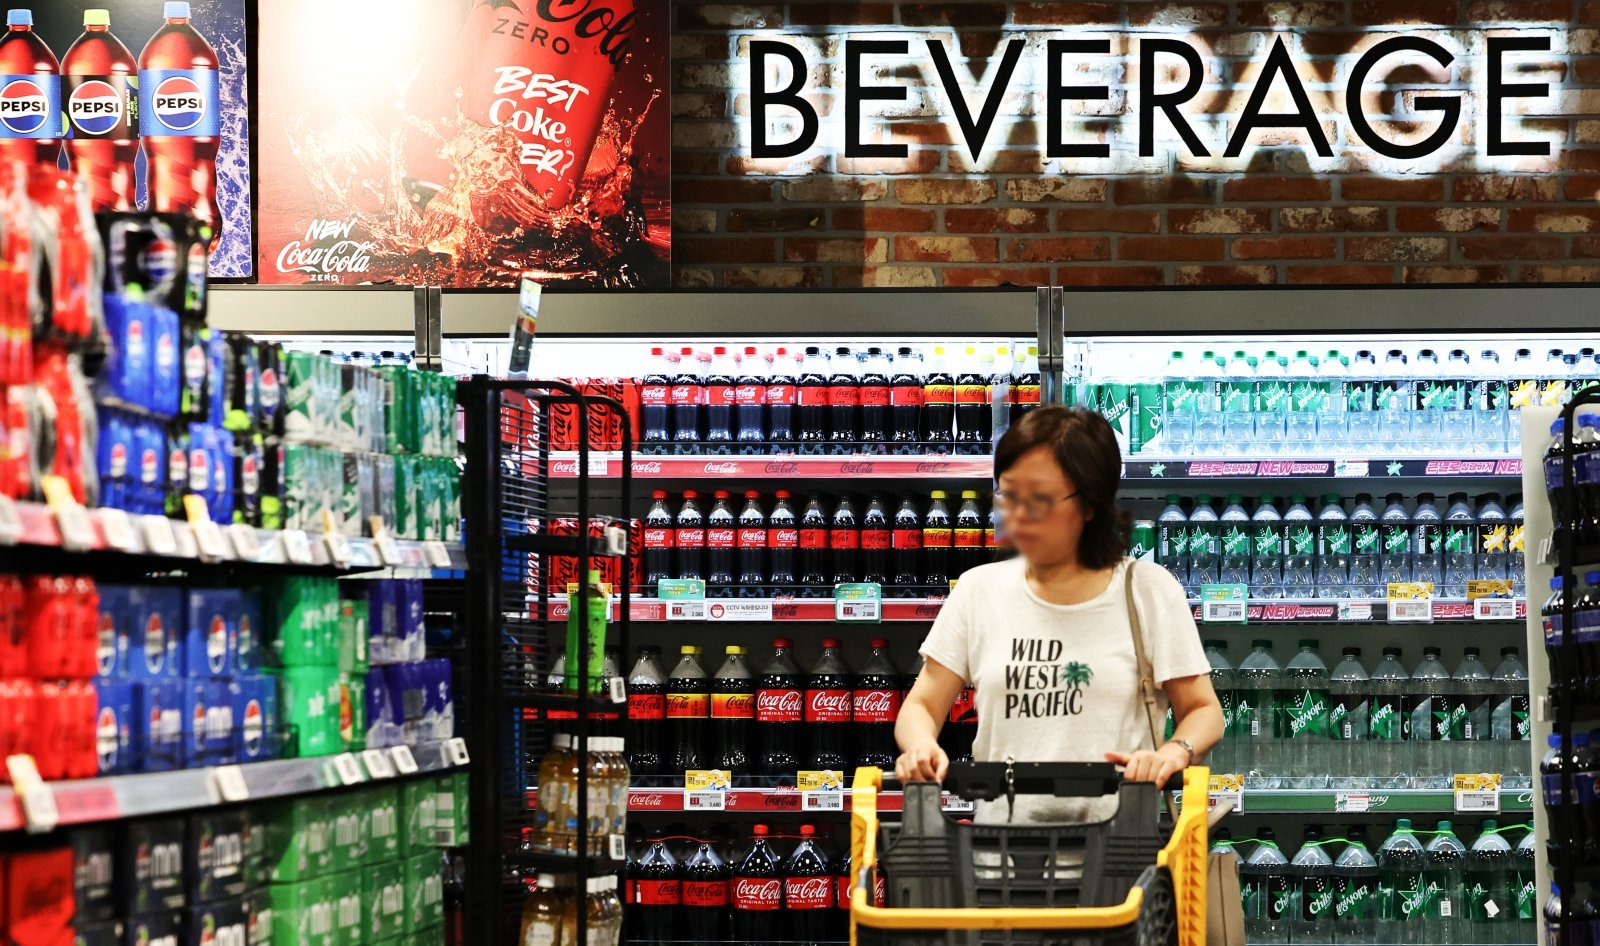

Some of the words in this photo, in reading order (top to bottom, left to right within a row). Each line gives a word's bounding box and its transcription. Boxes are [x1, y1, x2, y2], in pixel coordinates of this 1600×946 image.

[492, 18, 570, 55] ZERO
[493, 66, 589, 112] BEST
[748, 35, 1553, 163] BEVERAGE
[1, 101, 46, 112] PEPSI
[73, 102, 119, 113] PEPSI
[157, 98, 203, 109] PEPSI
[489, 98, 567, 143] Coke
[305, 216, 357, 241] NEW
[276, 240, 376, 273] Coca-Cola
[310, 274, 339, 282] ZERO
[1257, 461, 1295, 476] NEW
[1356, 529, 1378, 549] Chilsung
[1385, 529, 1409, 550] Chilsung
[1262, 605, 1301, 619] NEW
[1011, 638, 1063, 662] WILD
[1005, 664, 1062, 690] WEST
[1005, 688, 1083, 719] PACIFIC
[629, 795, 662, 806] Coca-Cola
[1336, 884, 1368, 916] 칠성사이다
